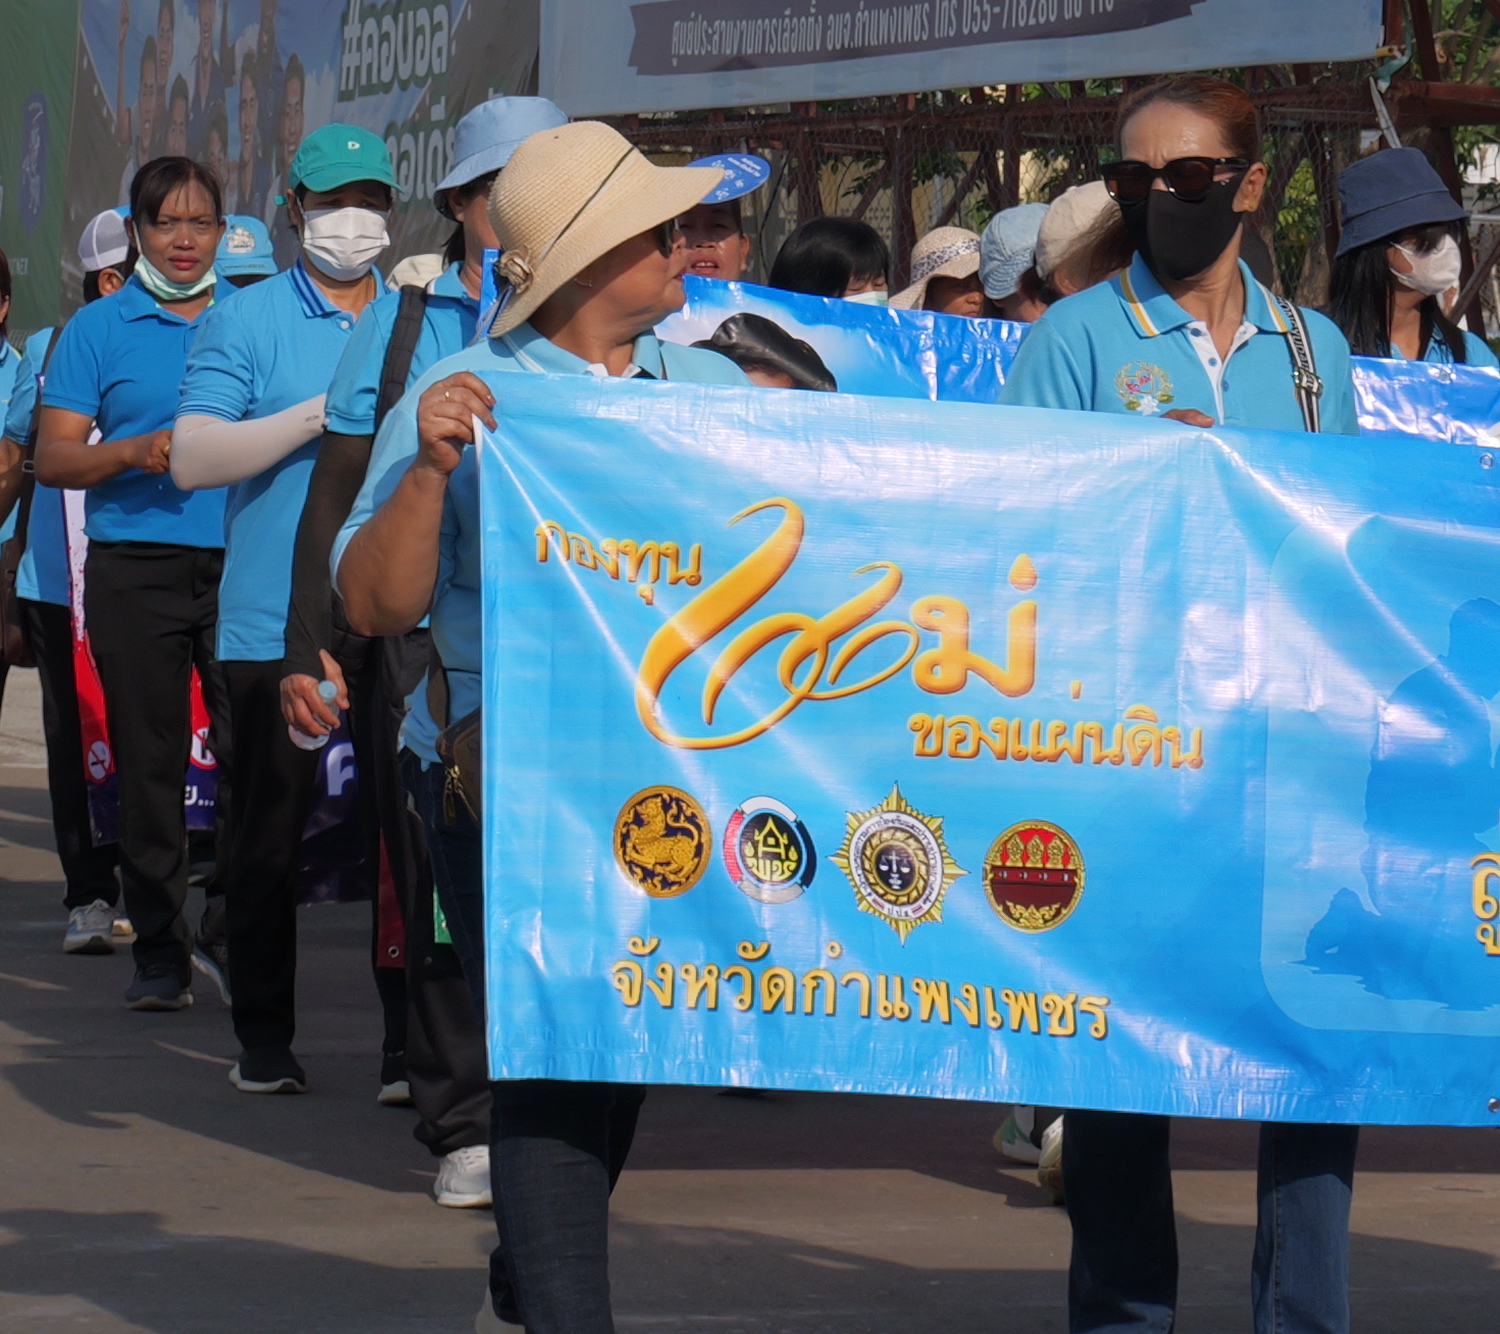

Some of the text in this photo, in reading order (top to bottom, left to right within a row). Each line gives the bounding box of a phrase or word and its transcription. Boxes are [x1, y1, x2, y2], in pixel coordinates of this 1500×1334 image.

[826, 1, 930, 51] อบจ.กำแพงเพชร
[533, 519, 702, 605] กองทุน
[908, 681, 1204, 770] ของแผ่นดิน
[609, 934, 1112, 1042] จังหวัดกำแพงเพชร
